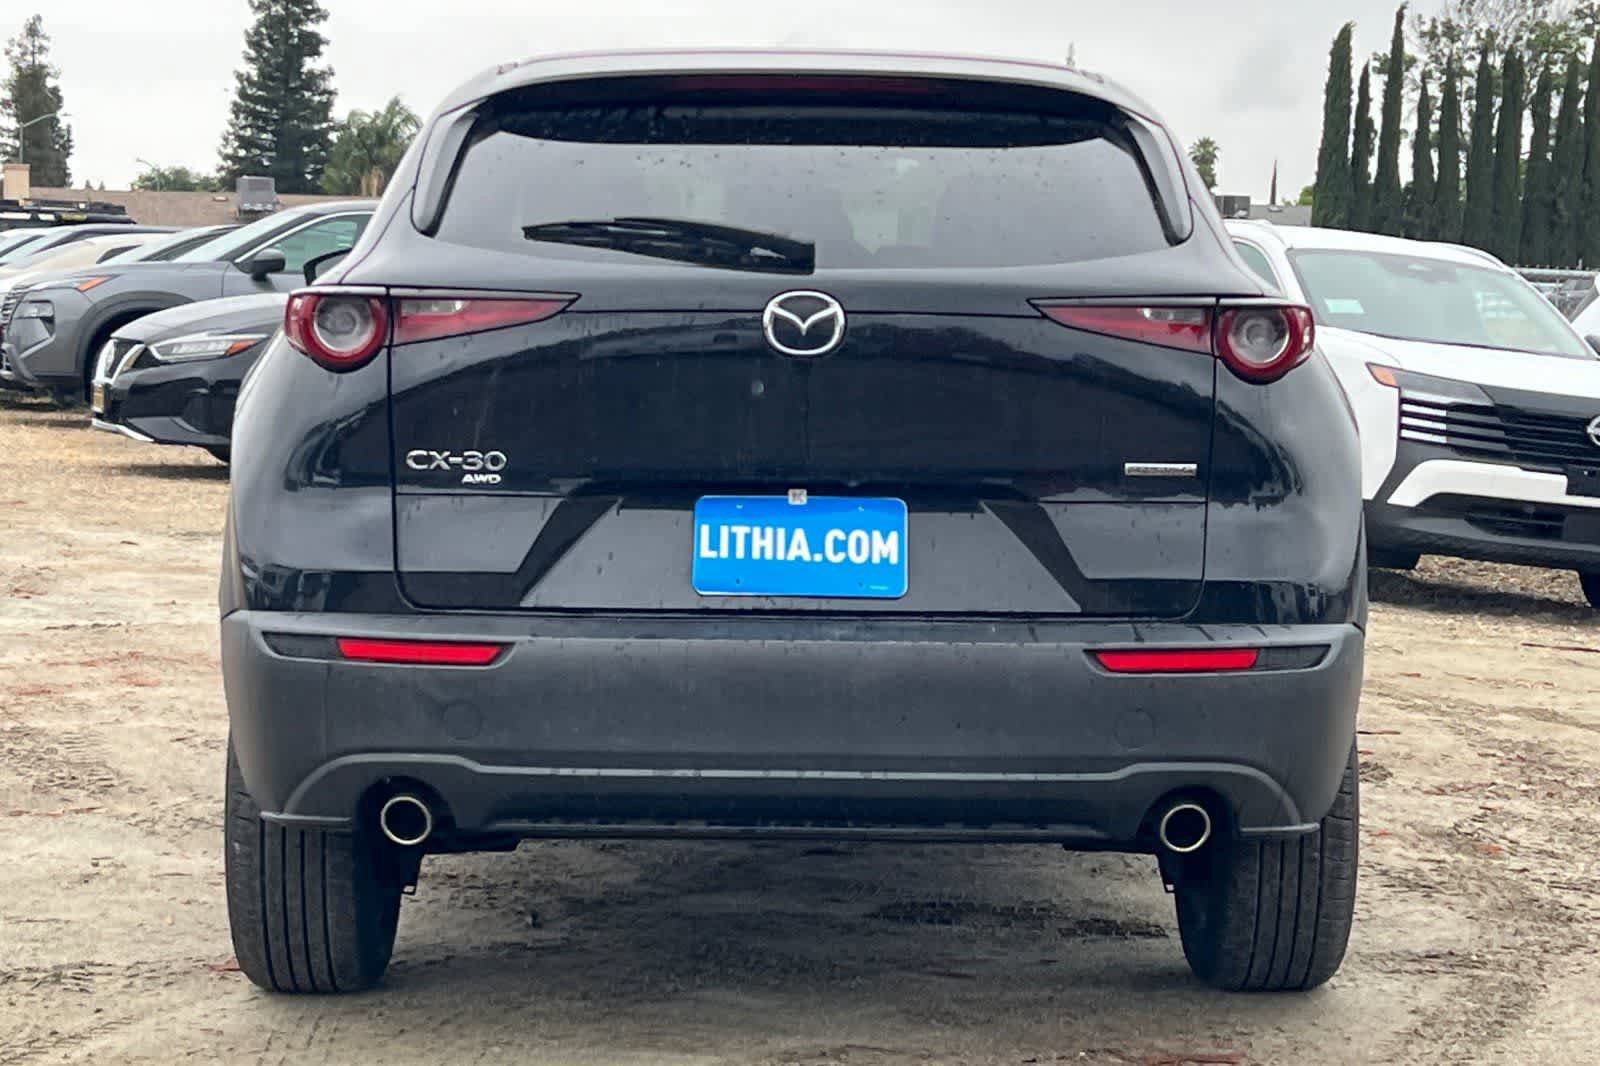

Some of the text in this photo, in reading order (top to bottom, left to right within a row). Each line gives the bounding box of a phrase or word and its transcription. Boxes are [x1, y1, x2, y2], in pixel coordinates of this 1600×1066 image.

[405, 449, 507, 471] CX-30
[461, 473, 502, 484] AWD
[700, 524, 899, 565] LITHIA.COM
